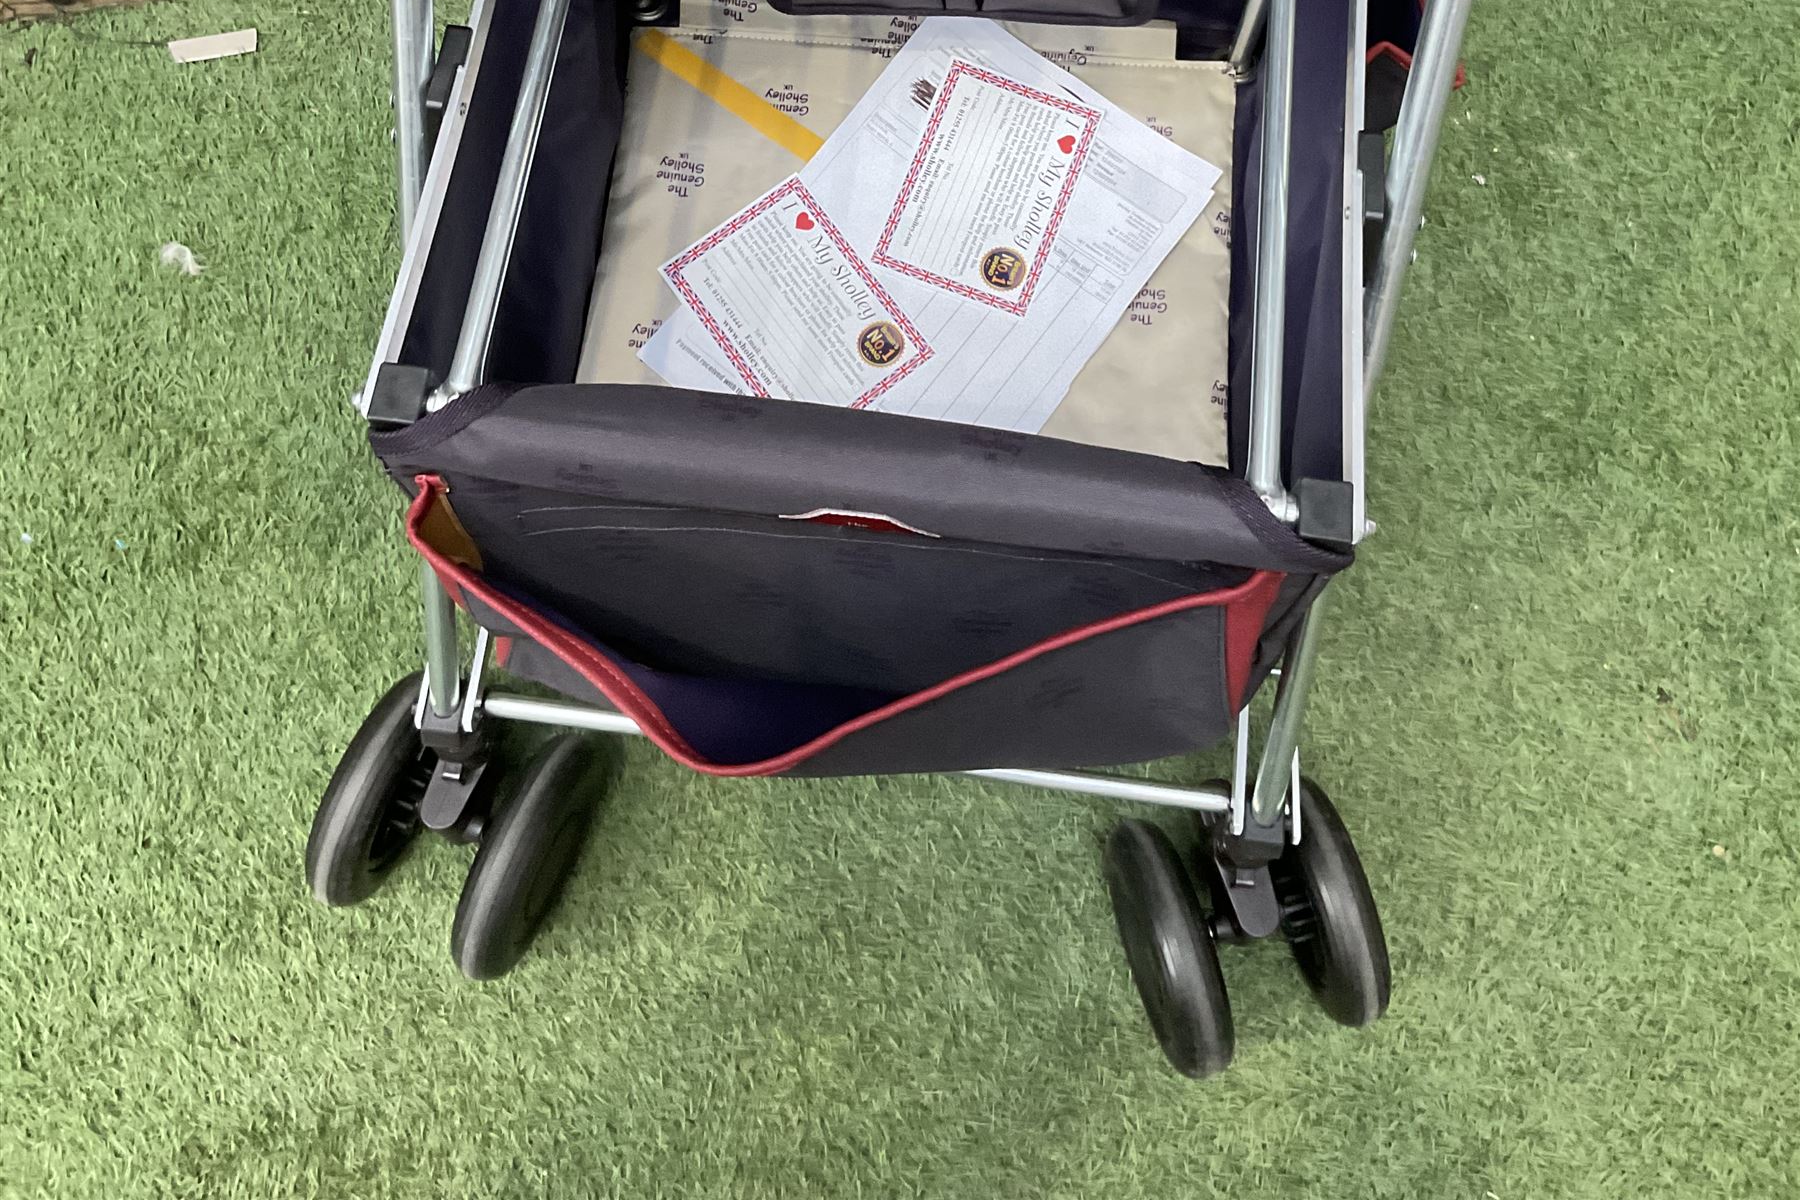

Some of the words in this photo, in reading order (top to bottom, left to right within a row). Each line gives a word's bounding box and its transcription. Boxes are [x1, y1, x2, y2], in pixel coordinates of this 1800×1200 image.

[723, 9, 744, 22] The
[890, 16, 921, 32] olley
[872, 47, 892, 58] The
[765, 88, 809, 104] Sholley
[659, 156, 705, 174] Sholley
[911, 133, 946, 204] www.sholley.com
[1036, 154, 1066, 187] My
[656, 170, 705, 187] Genuine
[667, 184, 689, 198] The
[1012, 189, 1054, 252] Sholley
[805, 232, 837, 268] My
[828, 264, 878, 322] Sholley
[990, 253, 1015, 286] No.1
[1130, 313, 1152, 325] The
[721, 318, 773, 386] www.sholley.com
[866, 328, 898, 362] No.1
